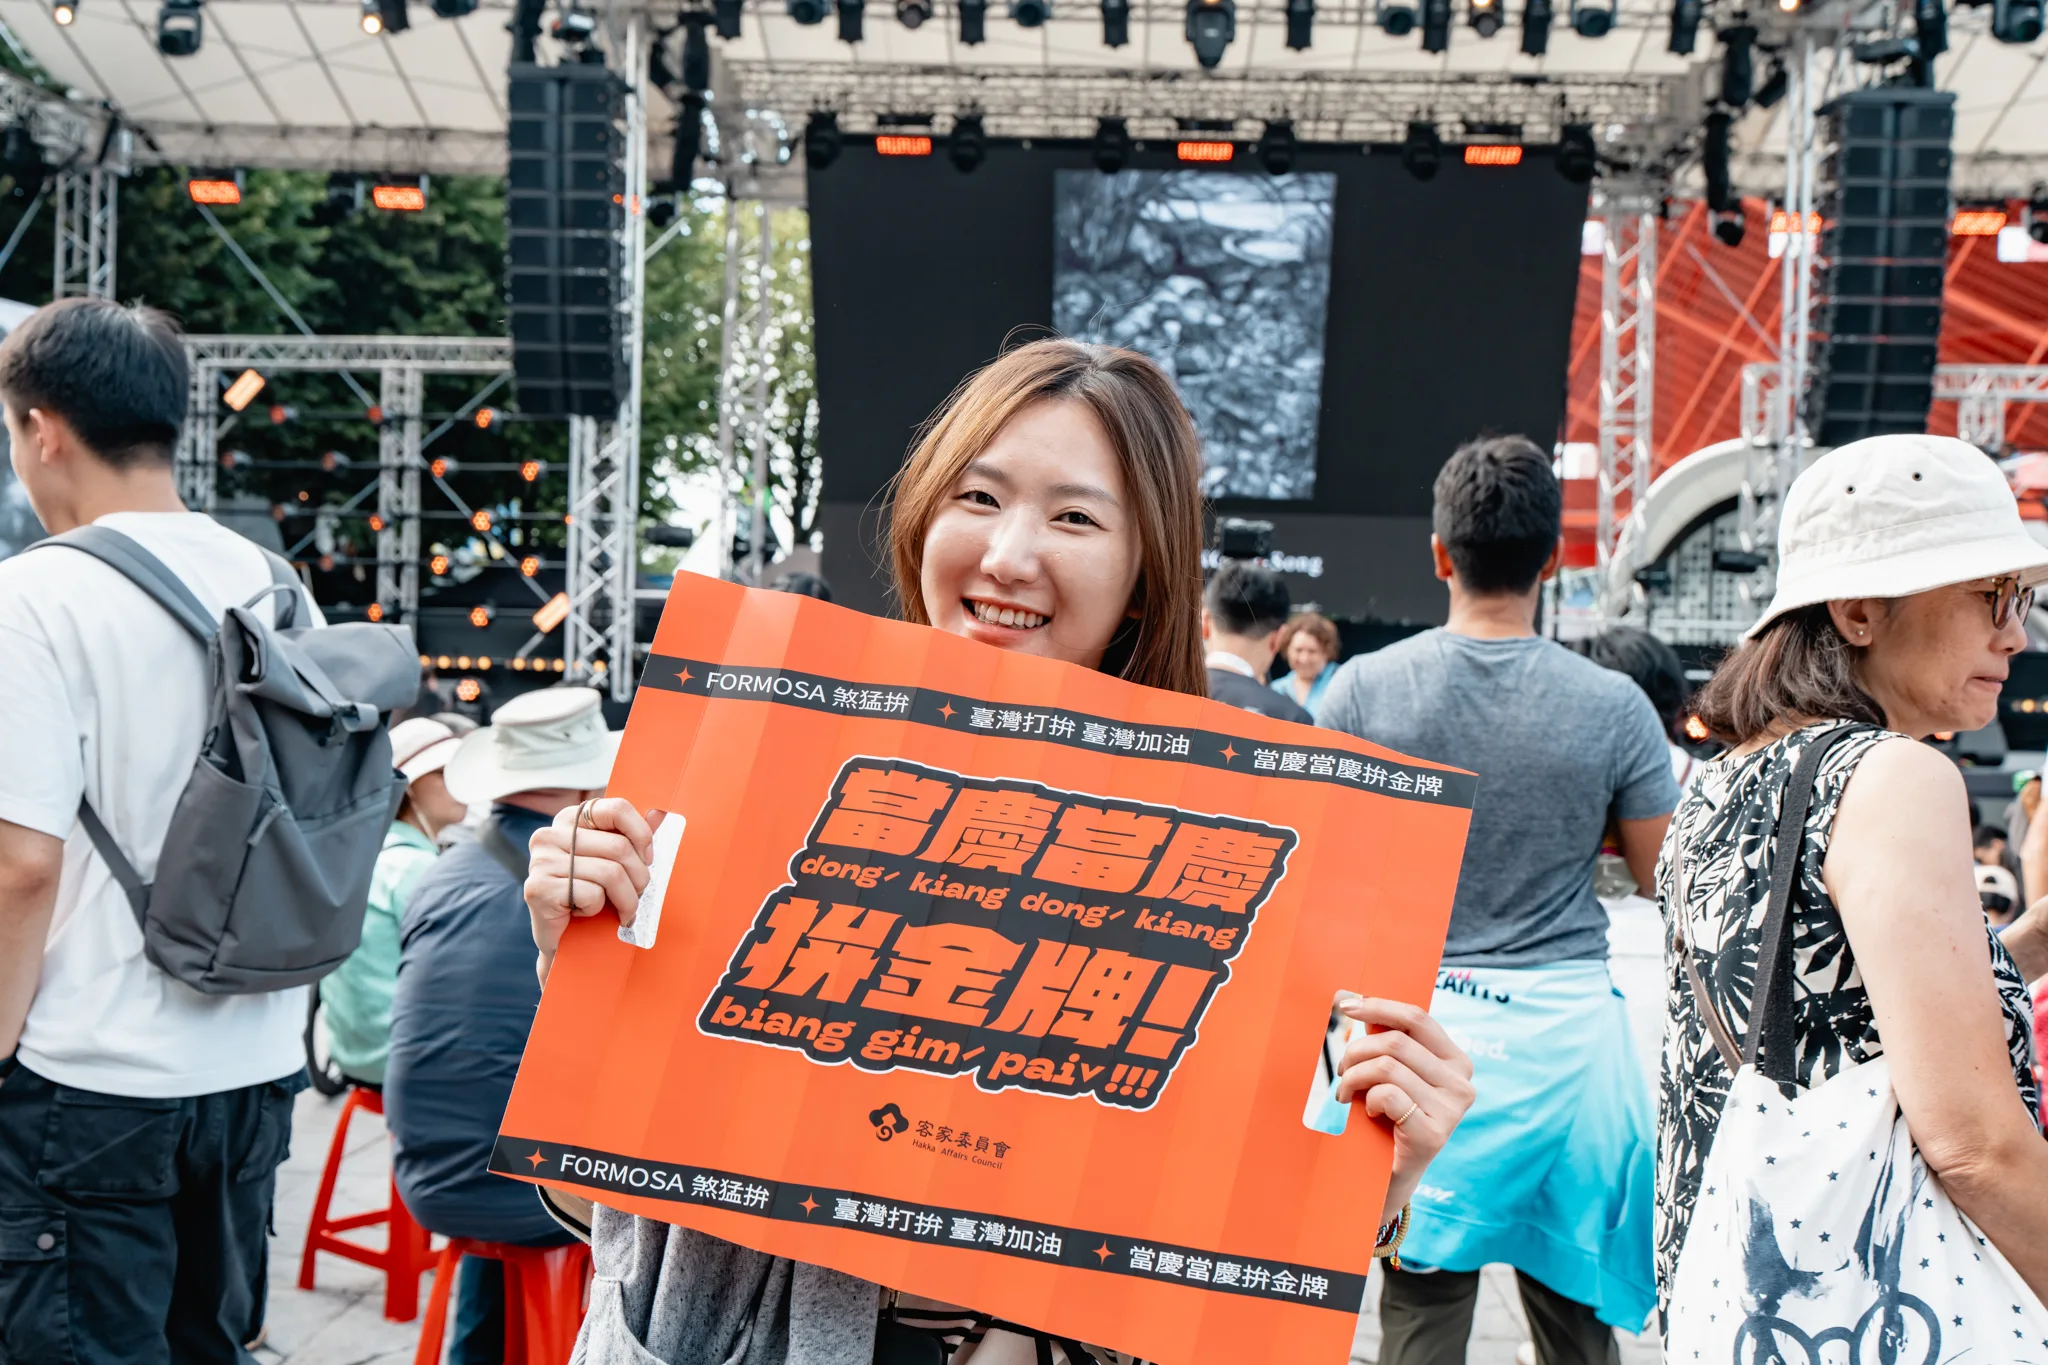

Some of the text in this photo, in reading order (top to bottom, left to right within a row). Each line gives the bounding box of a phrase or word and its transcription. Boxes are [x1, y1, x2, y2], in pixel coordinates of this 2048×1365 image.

[706, 672, 825, 702] FORMOSA
[1081, 722, 1189, 755] 臺灣加油
[818, 768, 1284, 913] 當慶當慶
[909, 873, 1009, 910] kiang
[1135, 909, 1237, 949] kiang
[710, 996, 855, 1053] biang
[912, 1139, 1003, 1169] Hakka Affairs Council
[915, 1120, 1012, 1159] 客家委員會
[561, 1154, 683, 1192] FORMOSA
[949, 1218, 1061, 1256] 臺灣加油
